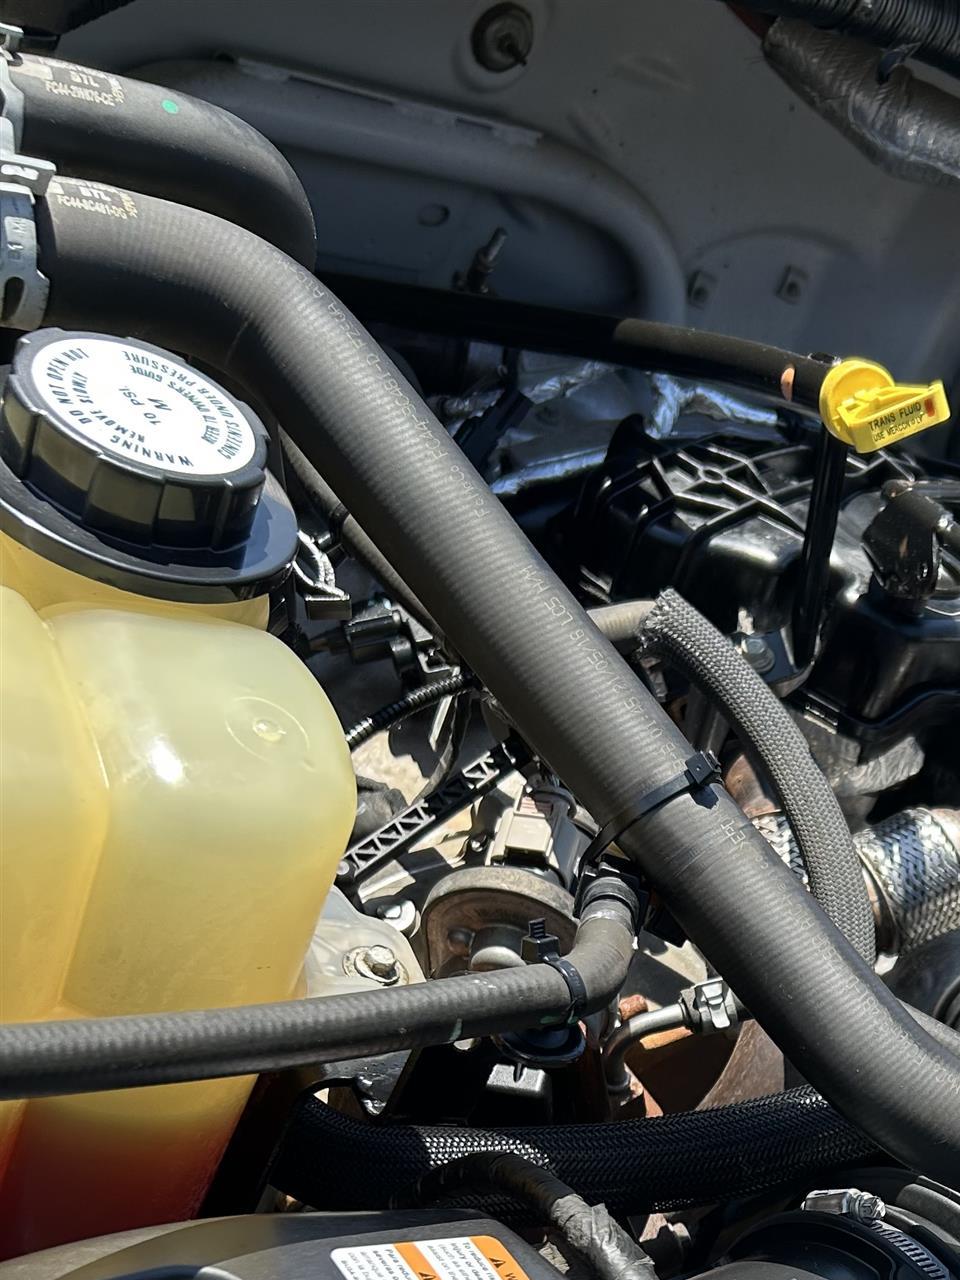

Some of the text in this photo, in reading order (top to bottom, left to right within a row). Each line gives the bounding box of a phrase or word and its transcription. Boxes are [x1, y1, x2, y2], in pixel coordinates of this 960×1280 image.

[130, 364, 162, 382] GUIDE
[48, 384, 73, 404] NOT
[71, 372, 145, 442] REMOVE SLOWLY
[122, 351, 242, 459] CONTENTS UNDER PRESSURE
[69, 409, 92, 423] DO
[867, 401, 922, 431] TRANS FLUID
[872, 431, 885, 441] USE
[109, 434, 193, 467] WARNING
[384, 1248, 401, 1263] Para
[437, 1243, 456, 1259] (such
[450, 1243, 469, 1259] injury
[468, 1249, 490, 1271] reduce
[372, 1250, 394, 1274] severas
